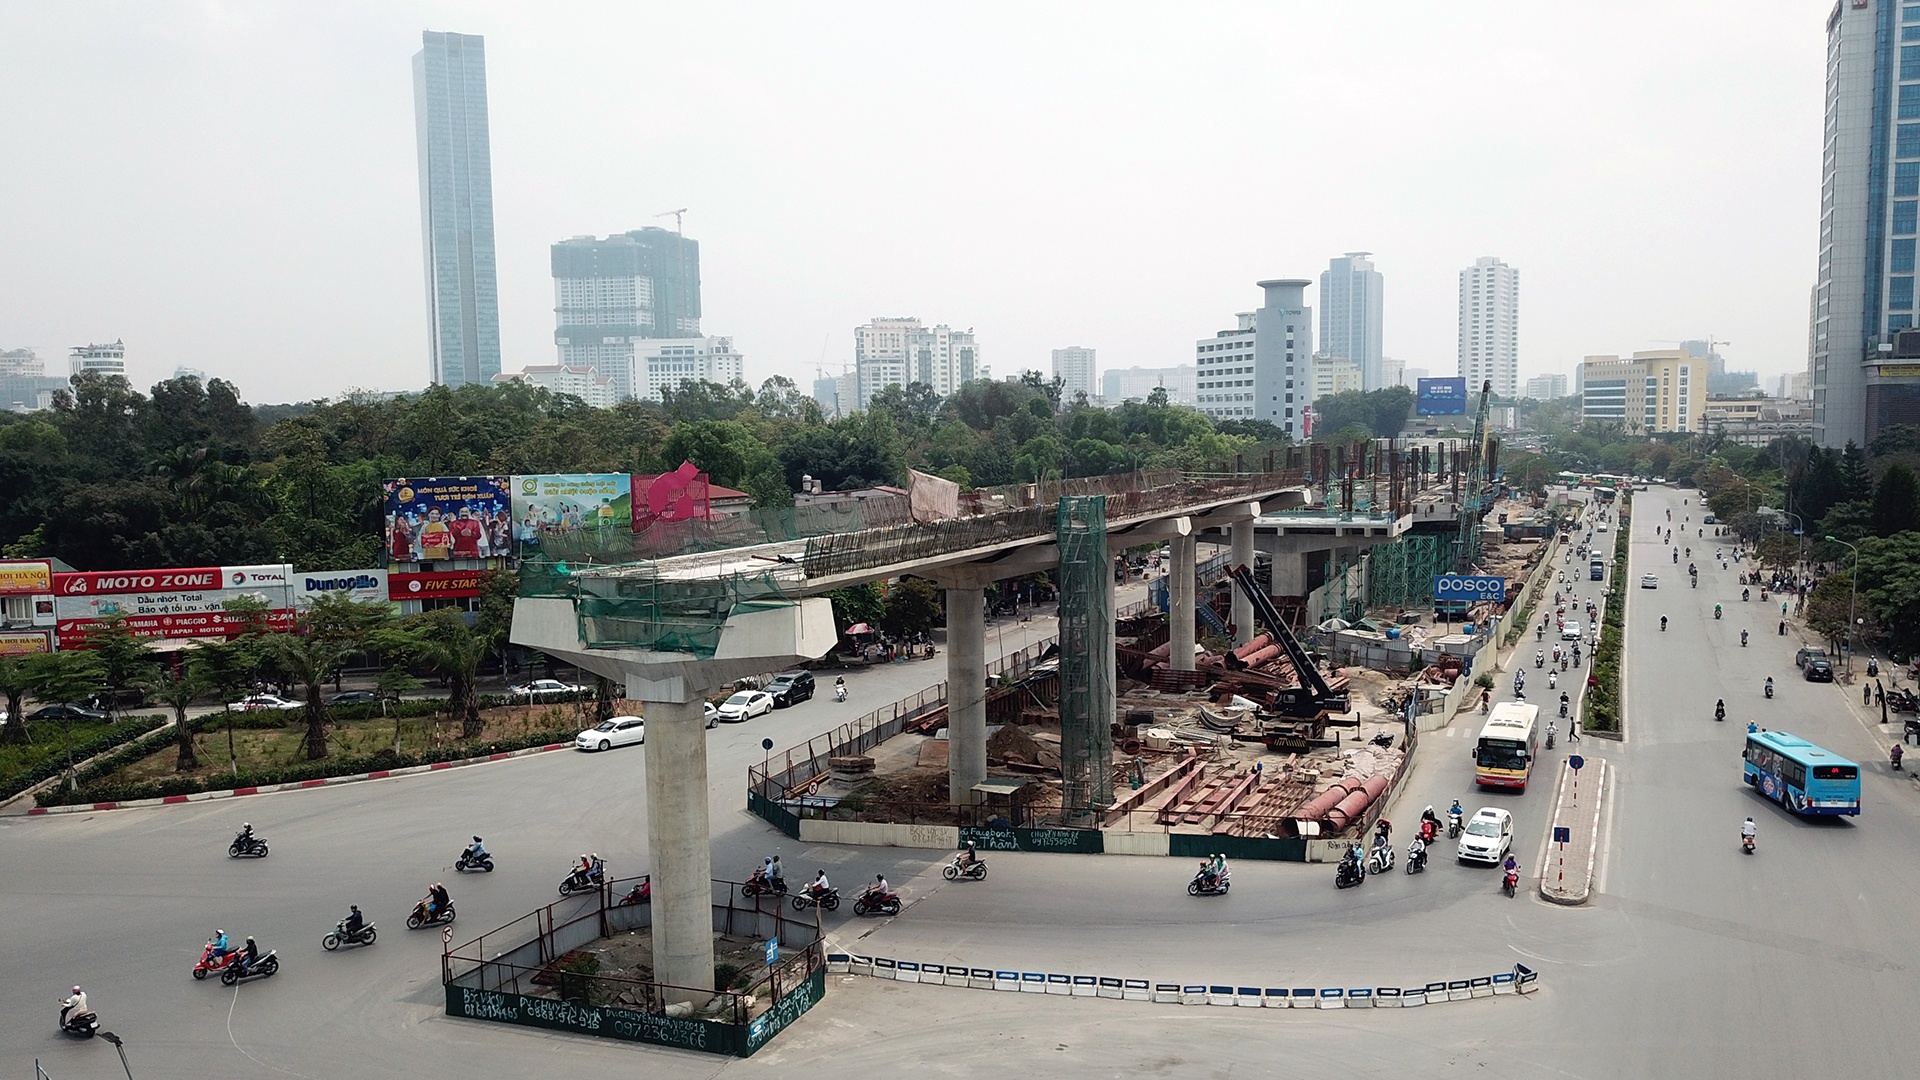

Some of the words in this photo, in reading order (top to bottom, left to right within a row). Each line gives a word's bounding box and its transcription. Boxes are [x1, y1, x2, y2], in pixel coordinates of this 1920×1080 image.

[96, 576, 155, 589] MOTO
[160, 573, 214, 587] ZONE
[305, 575, 379, 591] Dunlopillo
[425, 580, 449, 590] FIVE
[450, 579, 477, 589] STAR
[176, 617, 207, 626] PIAGGIO
